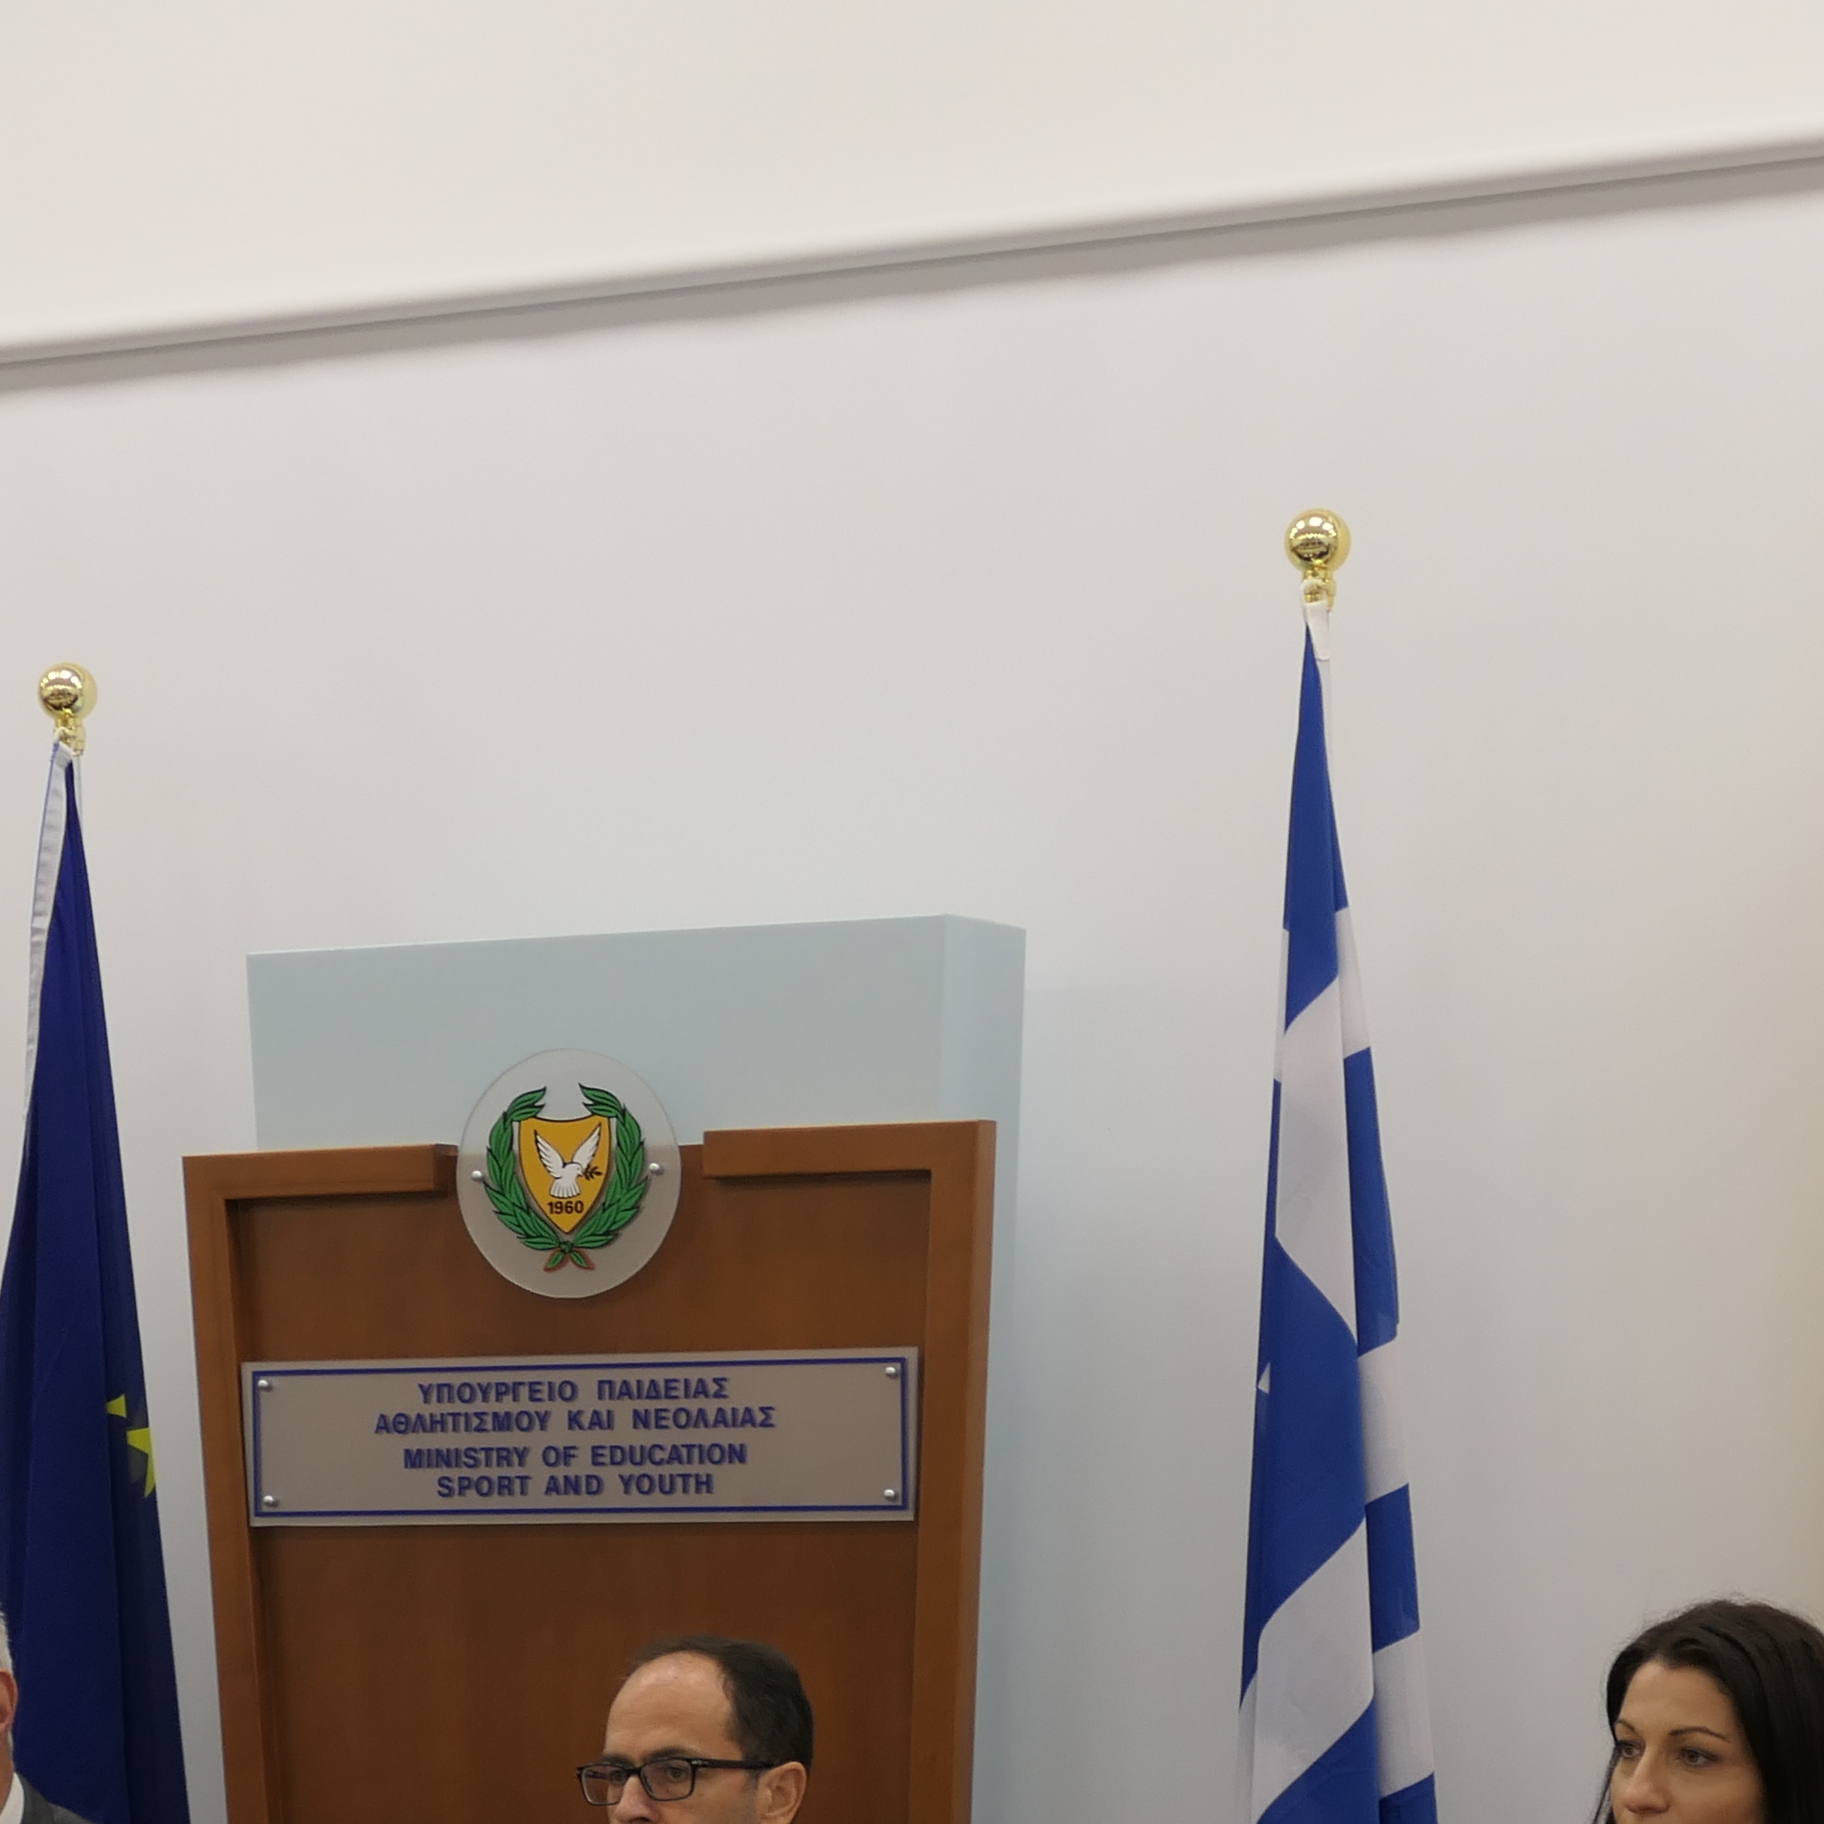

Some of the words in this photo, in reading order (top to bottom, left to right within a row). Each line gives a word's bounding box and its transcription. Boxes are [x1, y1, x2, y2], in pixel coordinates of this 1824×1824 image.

[547, 1200, 584, 1214] 1960
[417, 1379, 578, 1404] ΥΠΟΥΡΓΕΙΟ
[597, 1377, 730, 1401] ΠΑΙΔΕΙΑΣ
[374, 1410, 552, 1435] ΑΘΛΗΤΙΣΜΟΥ
[567, 1409, 615, 1431] ΚΑΙ
[632, 1406, 776, 1430] ΝΕΟΛΑΙΑΣ
[403, 1446, 531, 1469] MINISTRY
[542, 1445, 579, 1467] OF
[591, 1443, 747, 1466] EDUCATION
[437, 1475, 532, 1498] SPORT
[544, 1474, 604, 1496] AND
[618, 1472, 715, 1496] YOUTH
